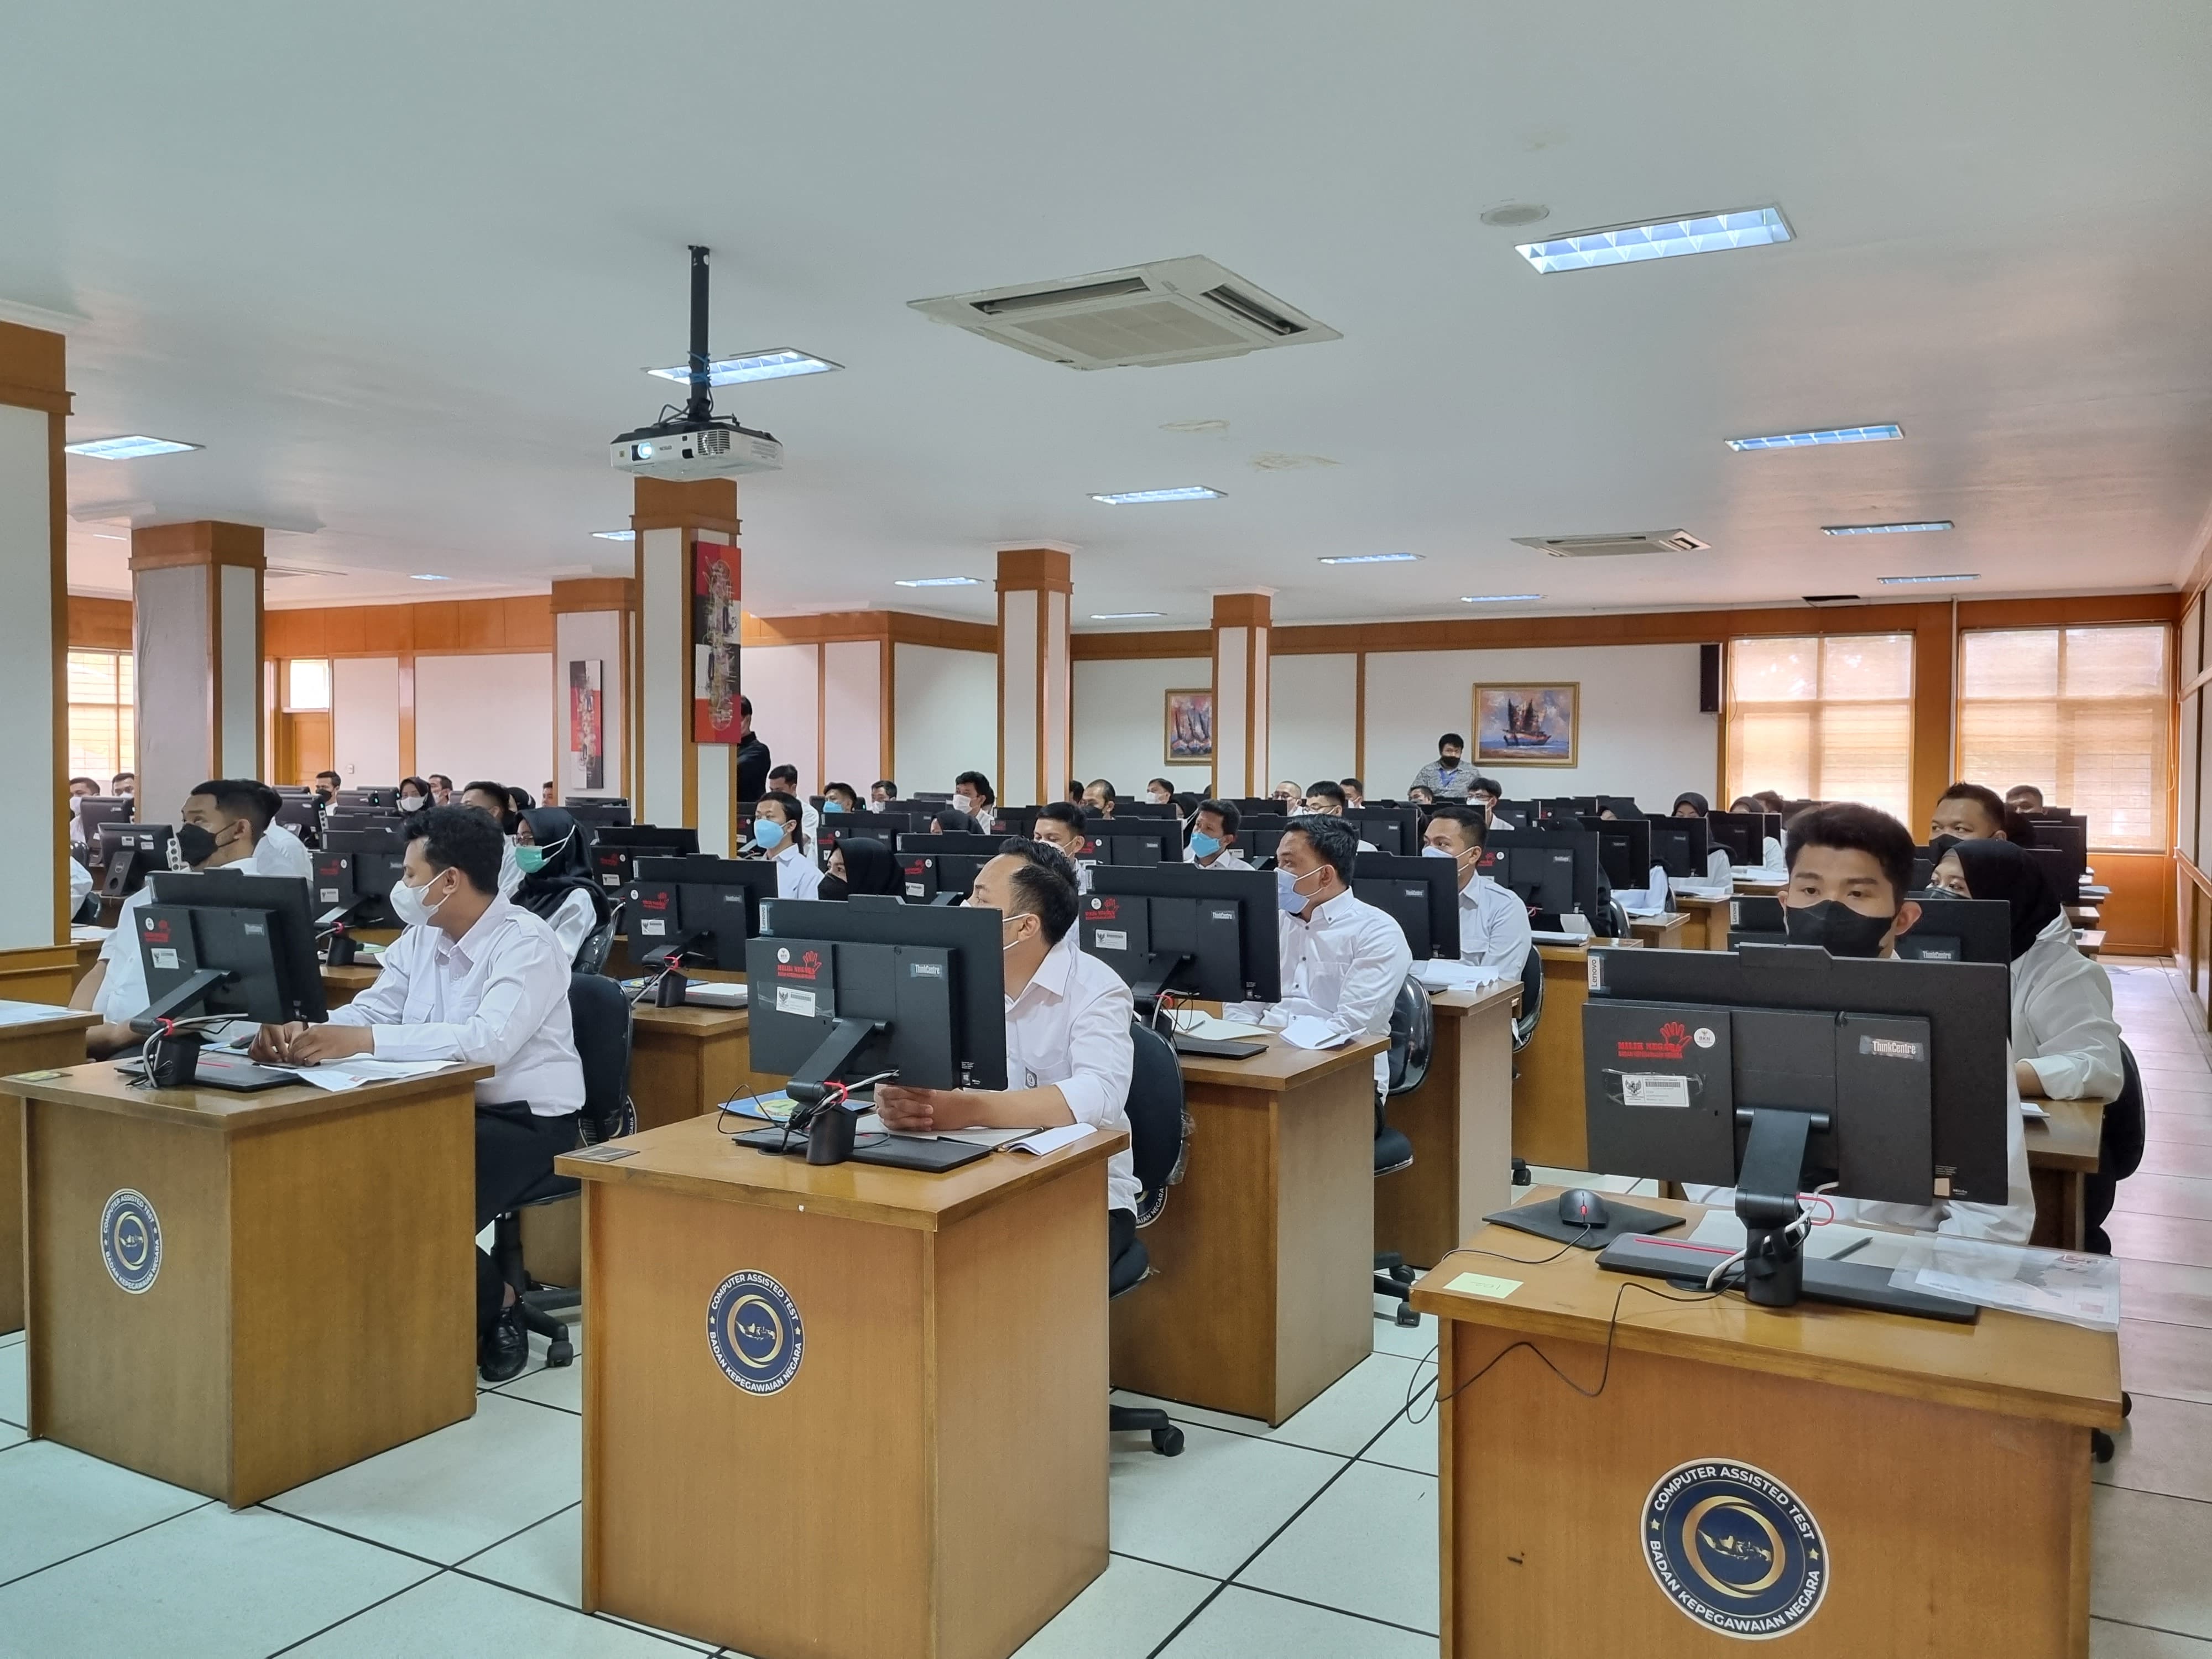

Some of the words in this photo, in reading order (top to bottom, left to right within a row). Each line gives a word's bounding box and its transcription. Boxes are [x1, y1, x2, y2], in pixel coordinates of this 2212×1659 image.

[1872, 1041, 1916, 1054] ThinkCentre
[103, 1198, 121, 1234] COMPUTER
[121, 1194, 144, 1208] ASSISTED
[143, 1204, 155, 1223] TEST
[1151, 1188, 1164, 1215] NEGARA
[711, 1274, 745, 1310] COMPUTER
[747, 1274, 784, 1298] ASSISTED
[784, 1296, 799, 1321] TEST
[709, 1332, 727, 1368] BADAN
[726, 1366, 784, 1392] KEPEGAWAIAN
[782, 1342, 802, 1381] NEGARA
[1654, 1466, 1717, 1511] COMPUTER
[1720, 1467, 1789, 1505] ASSISTED
[1788, 1504, 1815, 1540] TEST
[1650, 1540, 1681, 1592] BADAN
[1678, 1590, 1786, 1632] KEPEGAWAIAN
[1784, 1571, 1820, 1621] NEGARA
